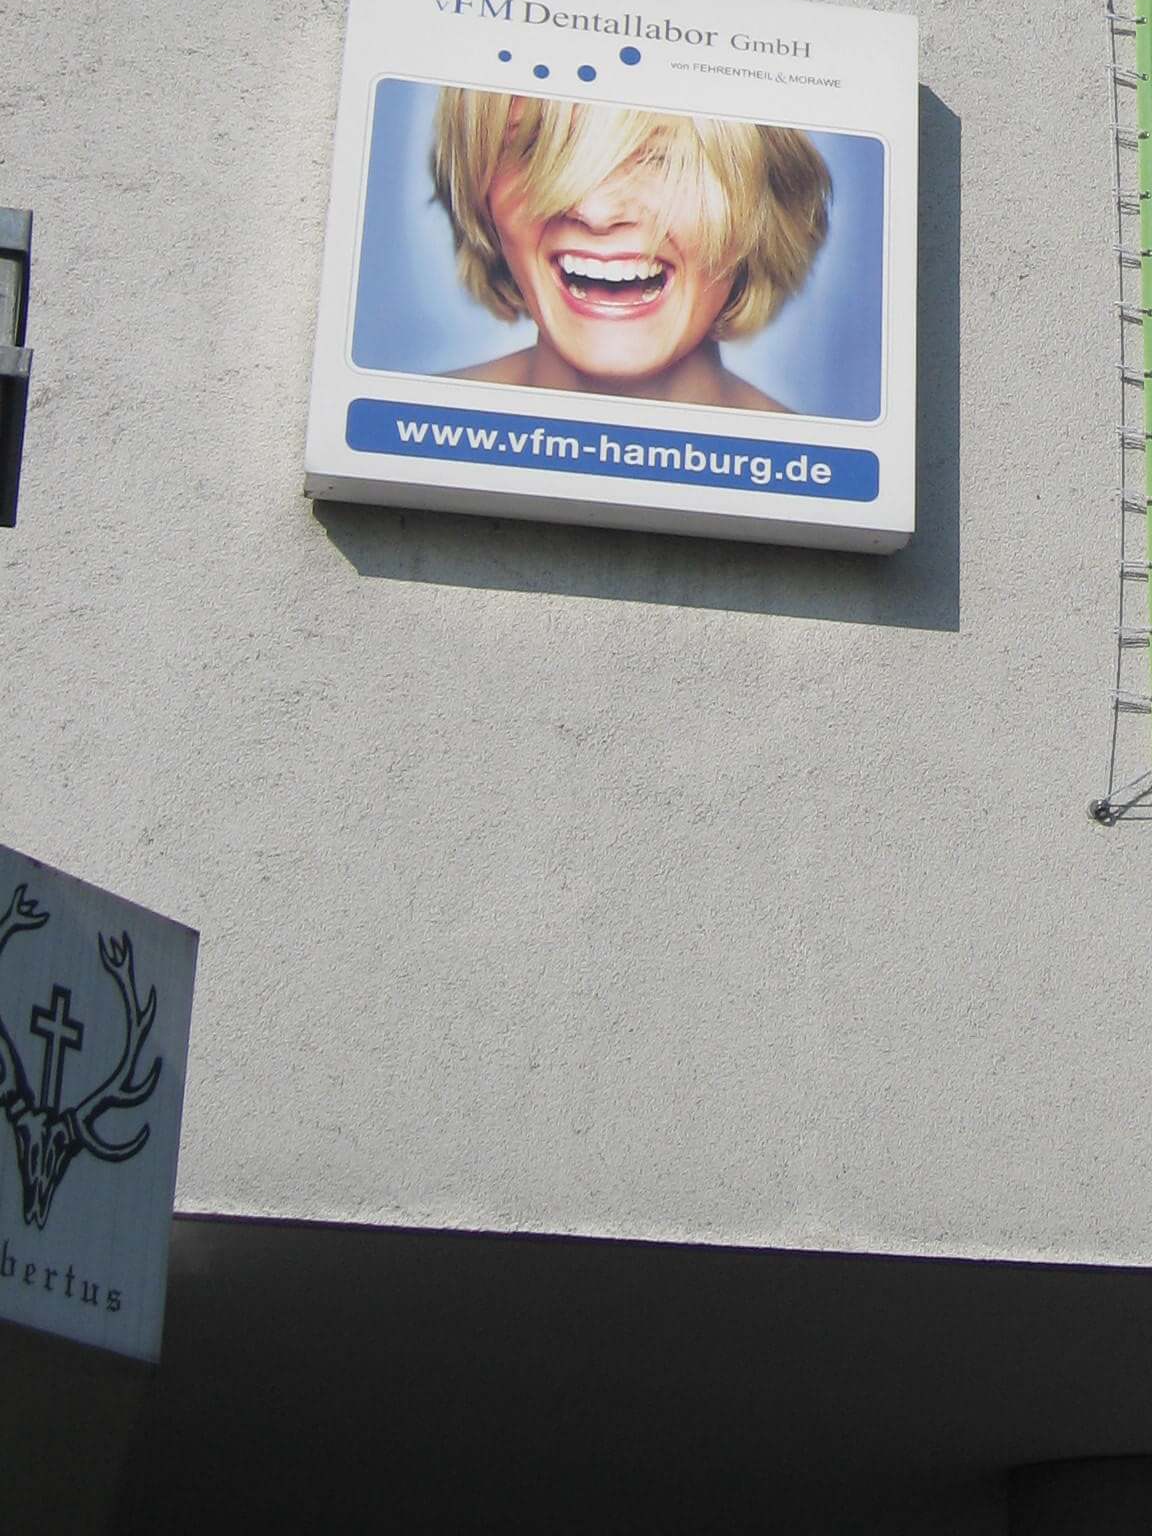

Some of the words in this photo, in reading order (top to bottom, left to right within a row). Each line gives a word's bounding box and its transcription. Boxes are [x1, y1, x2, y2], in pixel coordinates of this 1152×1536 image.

[522, 0, 719, 48] Dentallabor
[729, 32, 812, 59] GmbH
[775, 71, 788, 84] &
[396, 417, 833, 486] www.vfm-hamburg.de
